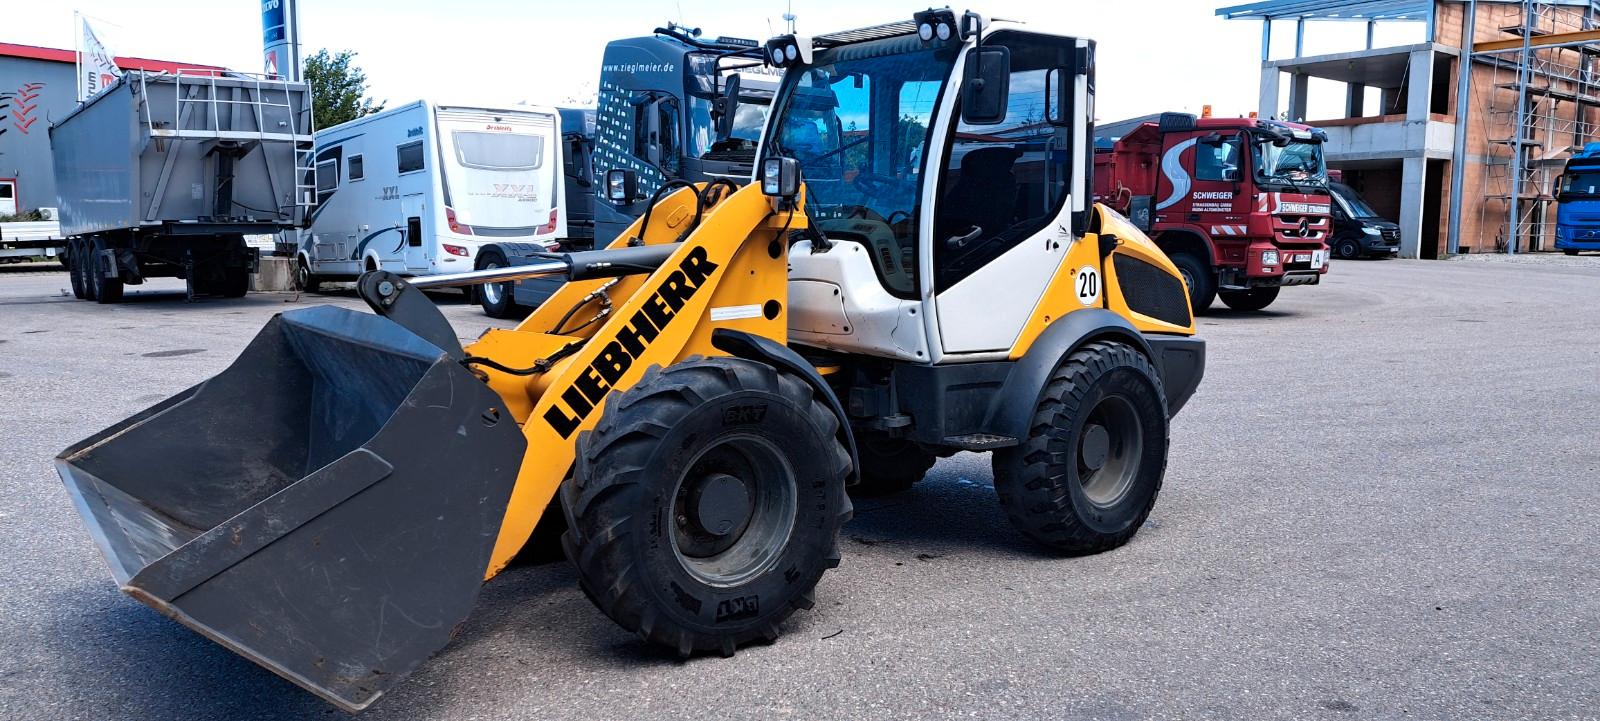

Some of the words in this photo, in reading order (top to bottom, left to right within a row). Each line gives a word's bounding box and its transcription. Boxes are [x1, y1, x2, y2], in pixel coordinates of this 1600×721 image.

[603, 62, 674, 74] www.zieglmeier.de
[1193, 191, 1233, 200] SCHWEIGER
[1282, 202, 1307, 213] SCHWEIGER
[1314, 253, 1321, 266] A
[1079, 271, 1097, 298] 20
[543, 246, 719, 440] LIEBHERR
